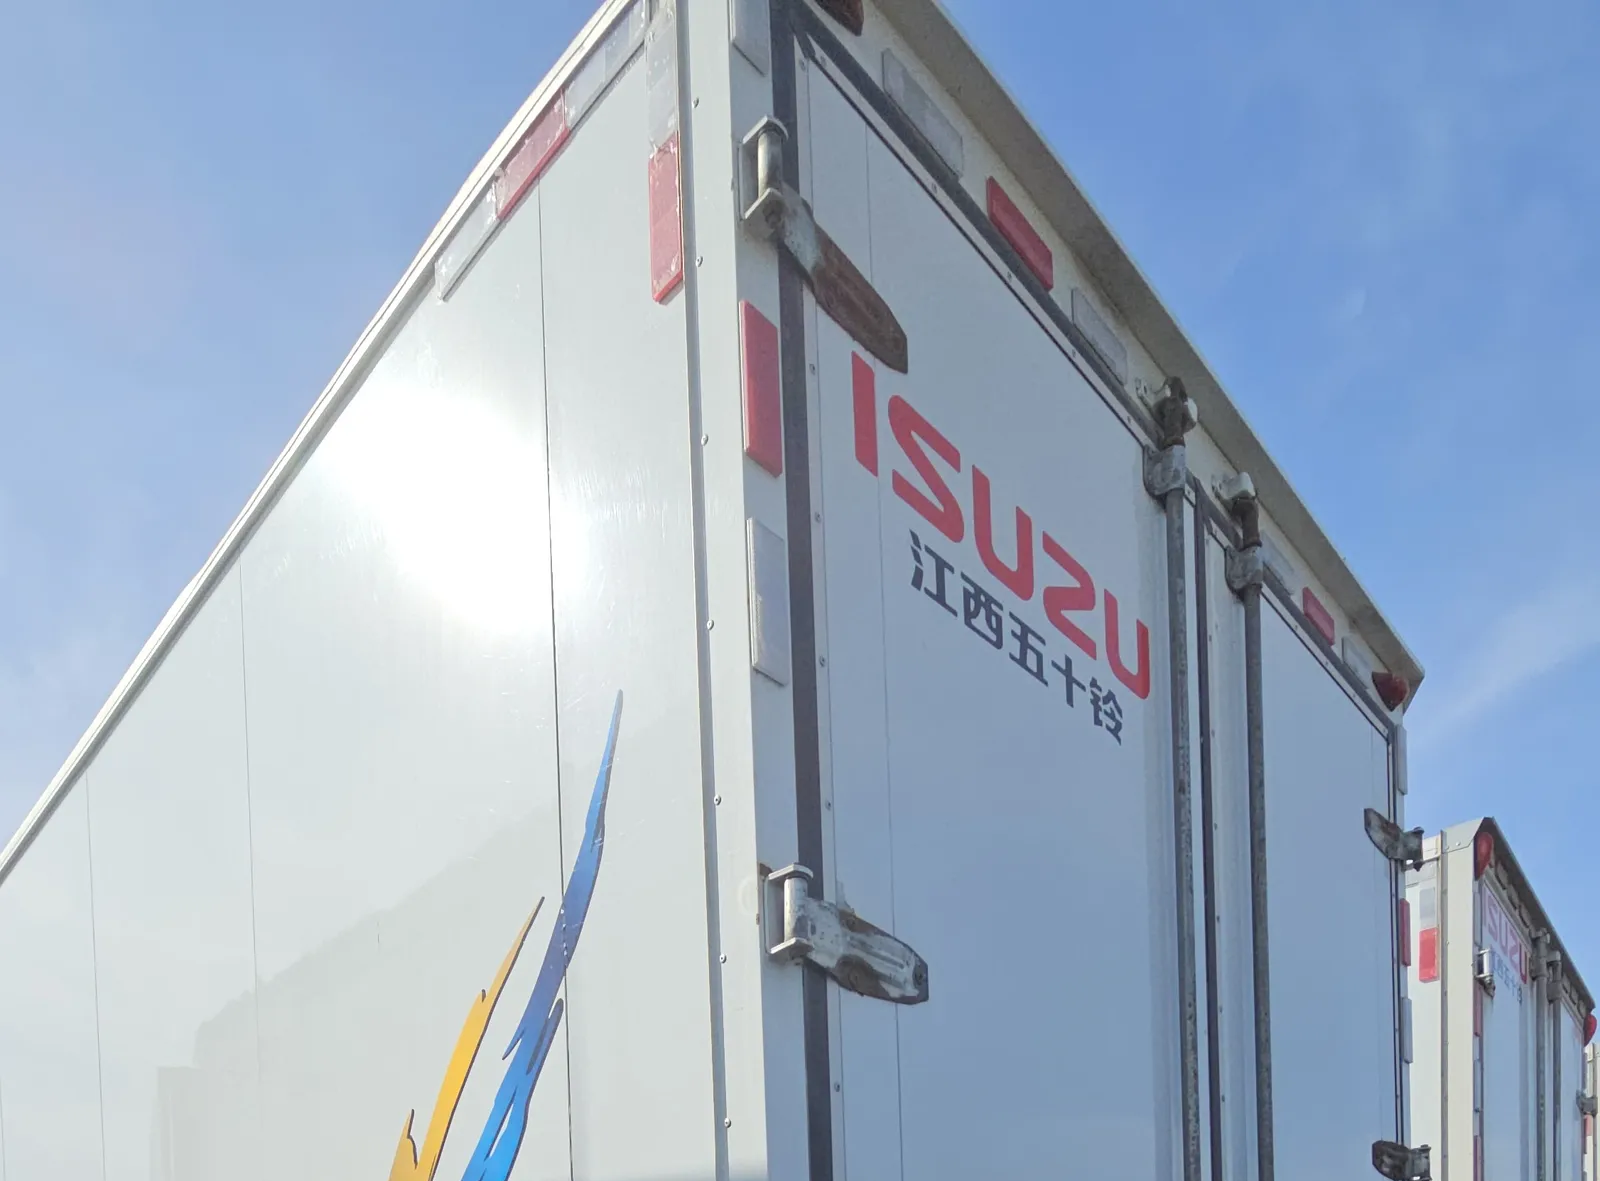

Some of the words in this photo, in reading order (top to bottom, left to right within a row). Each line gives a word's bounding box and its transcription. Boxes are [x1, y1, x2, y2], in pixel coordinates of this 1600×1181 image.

[852, 351, 1150, 700] ISUZU
[909, 529, 1123, 746] 江西五十铃
[1483, 884, 1527, 985] ISUZU
